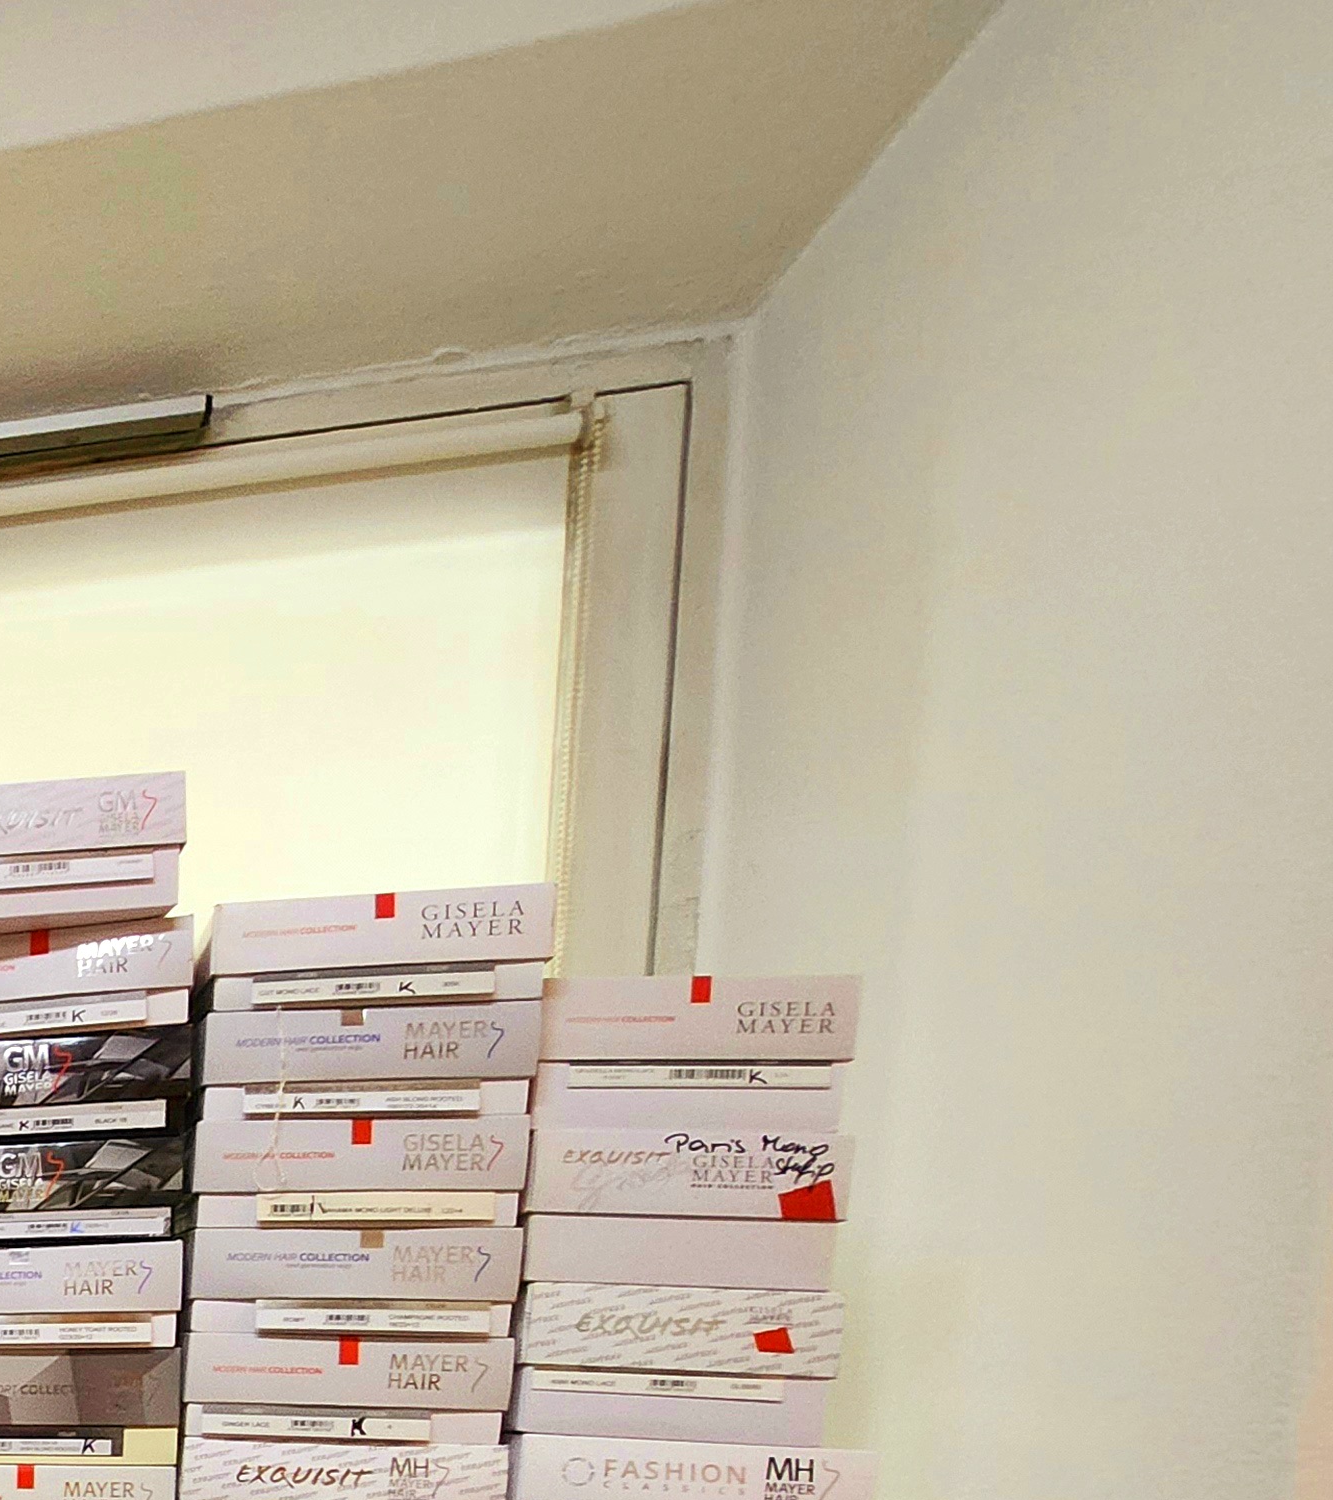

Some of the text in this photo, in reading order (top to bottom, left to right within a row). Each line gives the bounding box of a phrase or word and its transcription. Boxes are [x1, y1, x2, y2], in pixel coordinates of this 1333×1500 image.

[421, 900, 525, 921] GISELA
[421, 918, 524, 940] MAYER
[737, 1001, 836, 1017] GISELA
[736, 1018, 836, 1035] MAYER
[310, 1033, 381, 1046] COLLECTION
[3, 1045, 50, 1072] GM
[403, 1041, 460, 1060] HAIR
[664, 1132, 746, 1155] Paris
[402, 1153, 485, 1172] MAYER
[562, 1149, 671, 1164] EXQUISIT
[299, 1253, 370, 1262] COLLECTION
[64, 1279, 114, 1296] HAIR
[268, 1366, 323, 1375] COLLECTION
[389, 1353, 468, 1373] MAYER
[388, 1372, 441, 1392] HAIR
[236, 1465, 373, 1488] EXQUISIT
[390, 1457, 429, 1478] MH
[604, 1459, 747, 1484] FASHION
[765, 1457, 815, 1483] MH
[64, 1481, 134, 1498] MAYER
[764, 1482, 815, 1496] MAYER
